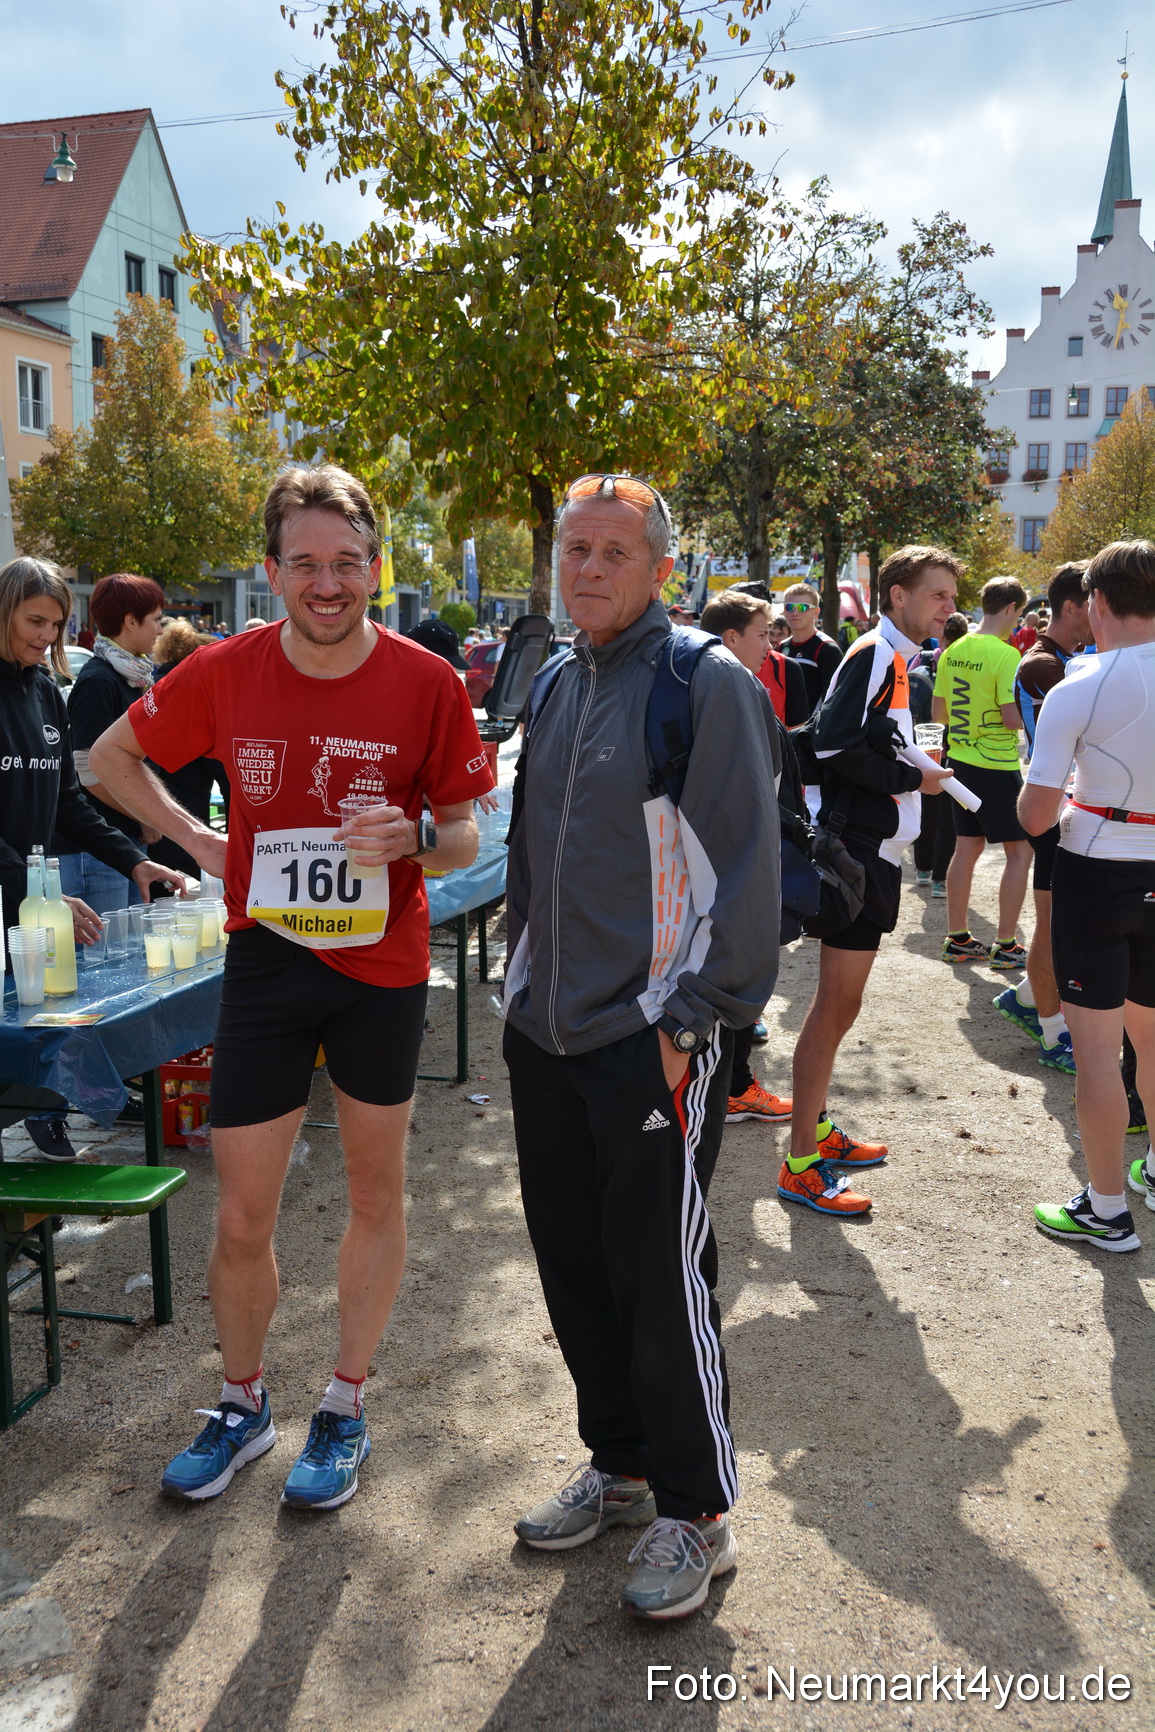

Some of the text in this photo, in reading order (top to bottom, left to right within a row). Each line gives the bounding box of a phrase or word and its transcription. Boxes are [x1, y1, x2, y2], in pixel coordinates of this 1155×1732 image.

[309, 735, 398, 755] 11. NEUMARKTER
[238, 748, 275, 759] IMMER
[322, 746, 384, 762] STADTLAUF
[0, 755, 23, 771] get
[237, 758, 276, 770] WIEDER
[239, 769, 272, 784] NEU
[242, 784, 272, 795] MARKT
[256, 840, 346, 856] PARTL Neuma
[281, 858, 362, 903] 160
[253, 899, 259, 907] A
[282, 914, 353, 933] Michael
[642, 1119, 671, 1131] adidas
